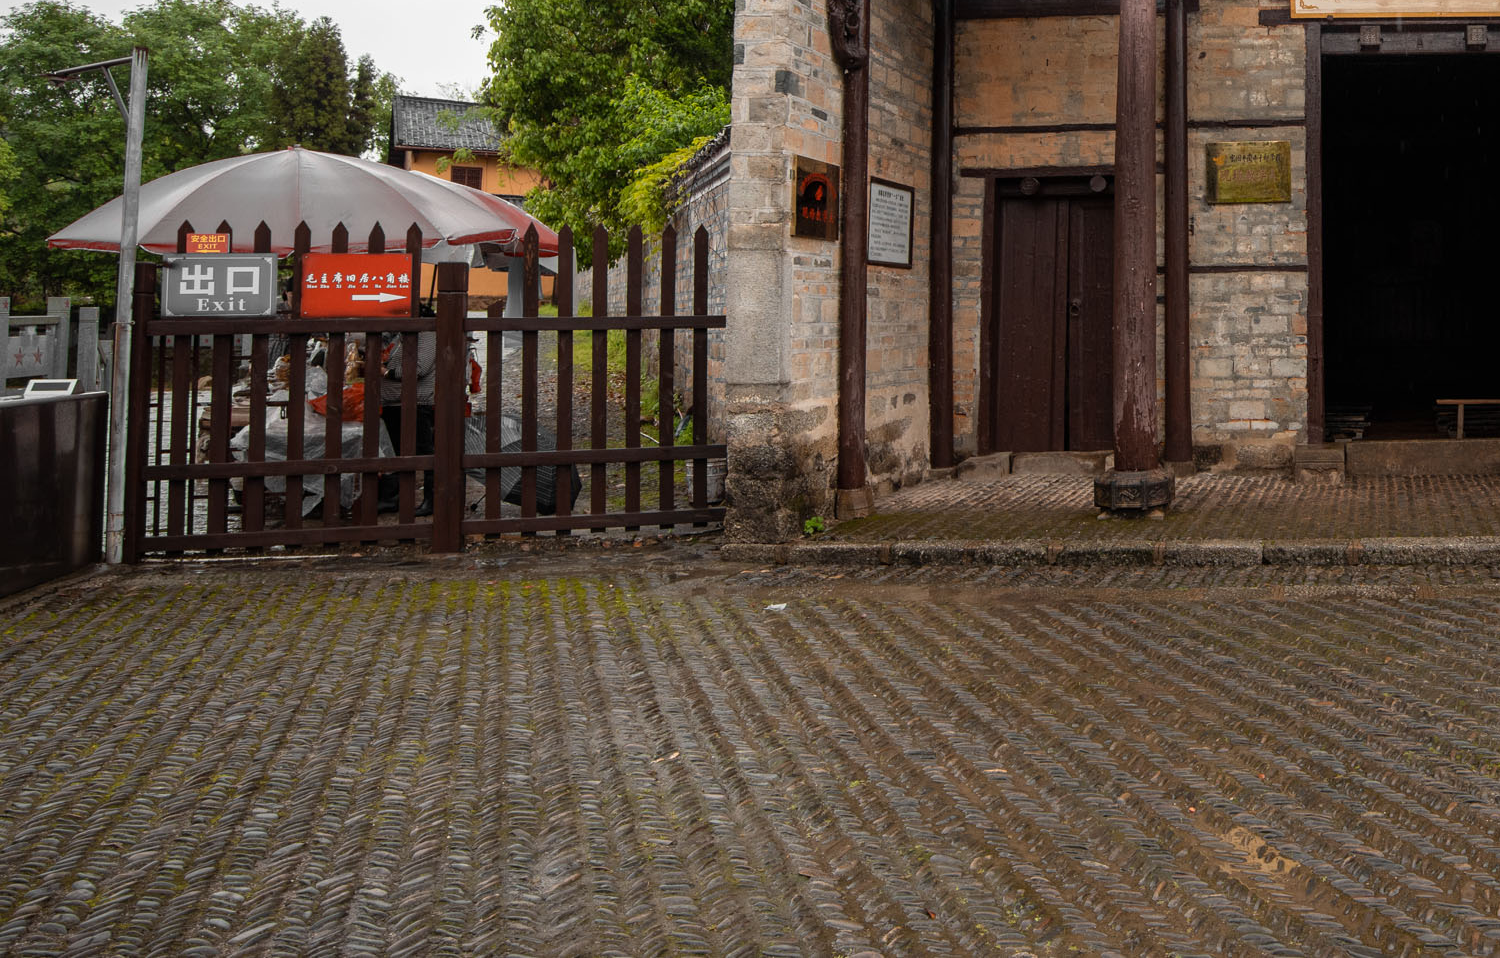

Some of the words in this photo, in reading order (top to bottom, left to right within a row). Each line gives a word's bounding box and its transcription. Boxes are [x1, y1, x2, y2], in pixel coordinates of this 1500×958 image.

[191, 235, 226, 243] 安全出口
[180, 264, 260, 295] 出口
[305, 271, 410, 284] 毛主席旧居八角楼
[196, 297, 247, 312] Exit
